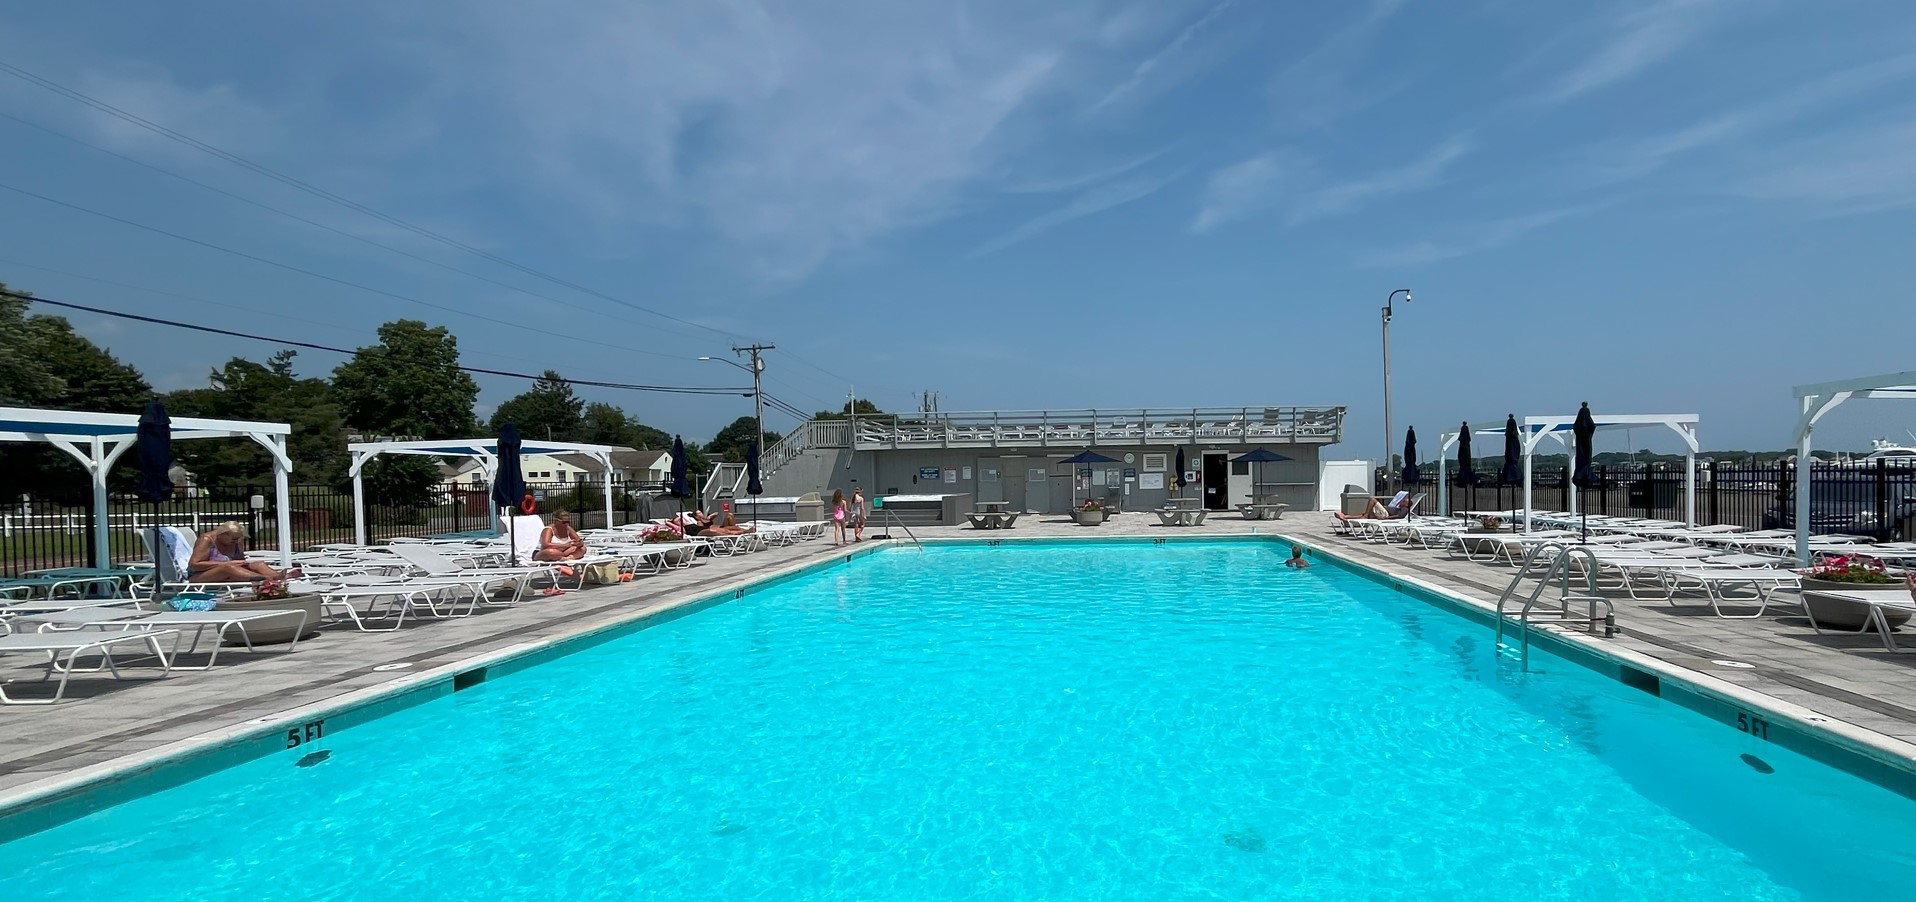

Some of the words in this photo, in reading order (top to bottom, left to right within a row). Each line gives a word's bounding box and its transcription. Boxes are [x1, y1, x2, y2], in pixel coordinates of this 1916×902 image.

[286, 728, 302, 749] 5
[305, 719, 325, 743] FT
[1737, 711, 1749, 733] 5
[1751, 716, 1769, 741] FT
